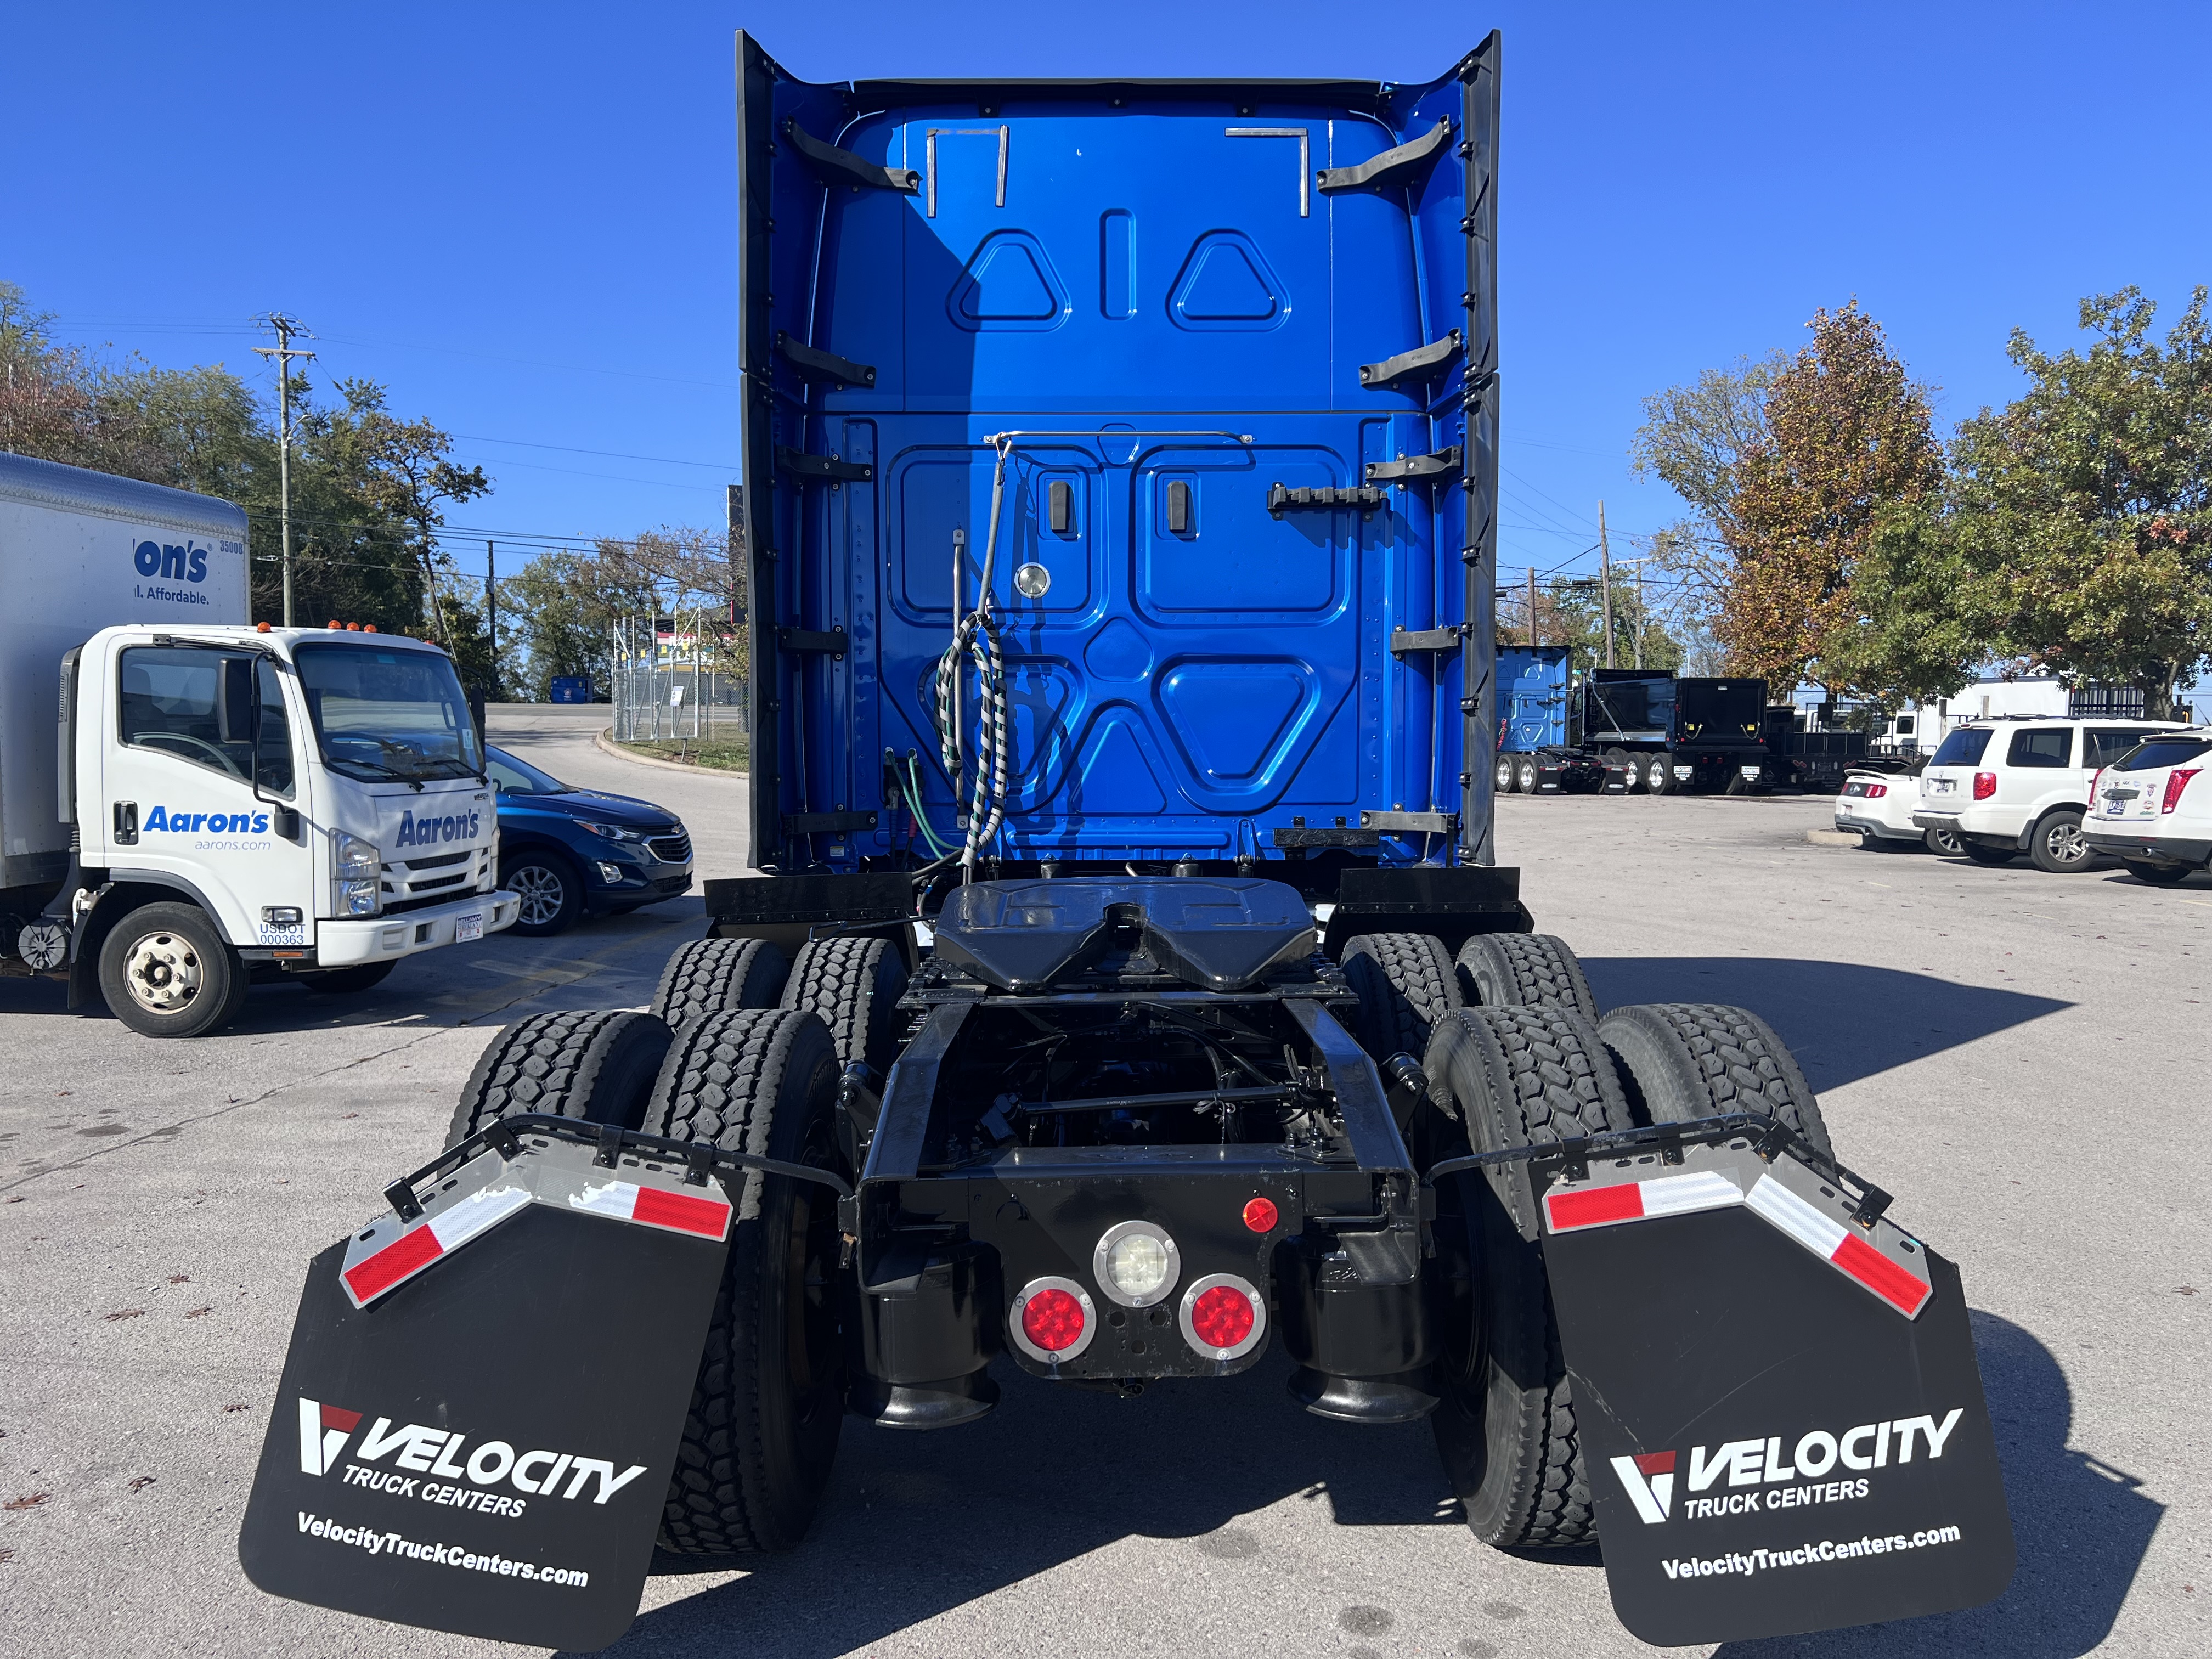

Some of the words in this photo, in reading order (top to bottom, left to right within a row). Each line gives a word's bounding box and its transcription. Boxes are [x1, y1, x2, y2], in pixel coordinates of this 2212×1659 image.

[132, 538, 208, 583] on's
[220, 539, 243, 555] 35008
[146, 586, 210, 605] Affordable.
[142, 806, 269, 833] Aaron's
[395, 808, 479, 848] Aaron's
[195, 840, 271, 851] aarons.com
[259, 923, 306, 934] USDOT
[261, 934, 304, 945] 000363
[357, 1417, 648, 1504] VELOCITY
[1687, 1408, 1965, 1492] VELOCITY
[342, 1464, 421, 1498] TRUCK
[421, 1482, 527, 1518] CENTERS
[1684, 1492, 1760, 1520] TRUCK
[1765, 1478, 1870, 1510] CENTERS
[298, 1511, 590, 1588] VelocityTruckCenters.com
[1661, 1525, 1961, 1579] VelocityTruckCenters.com
